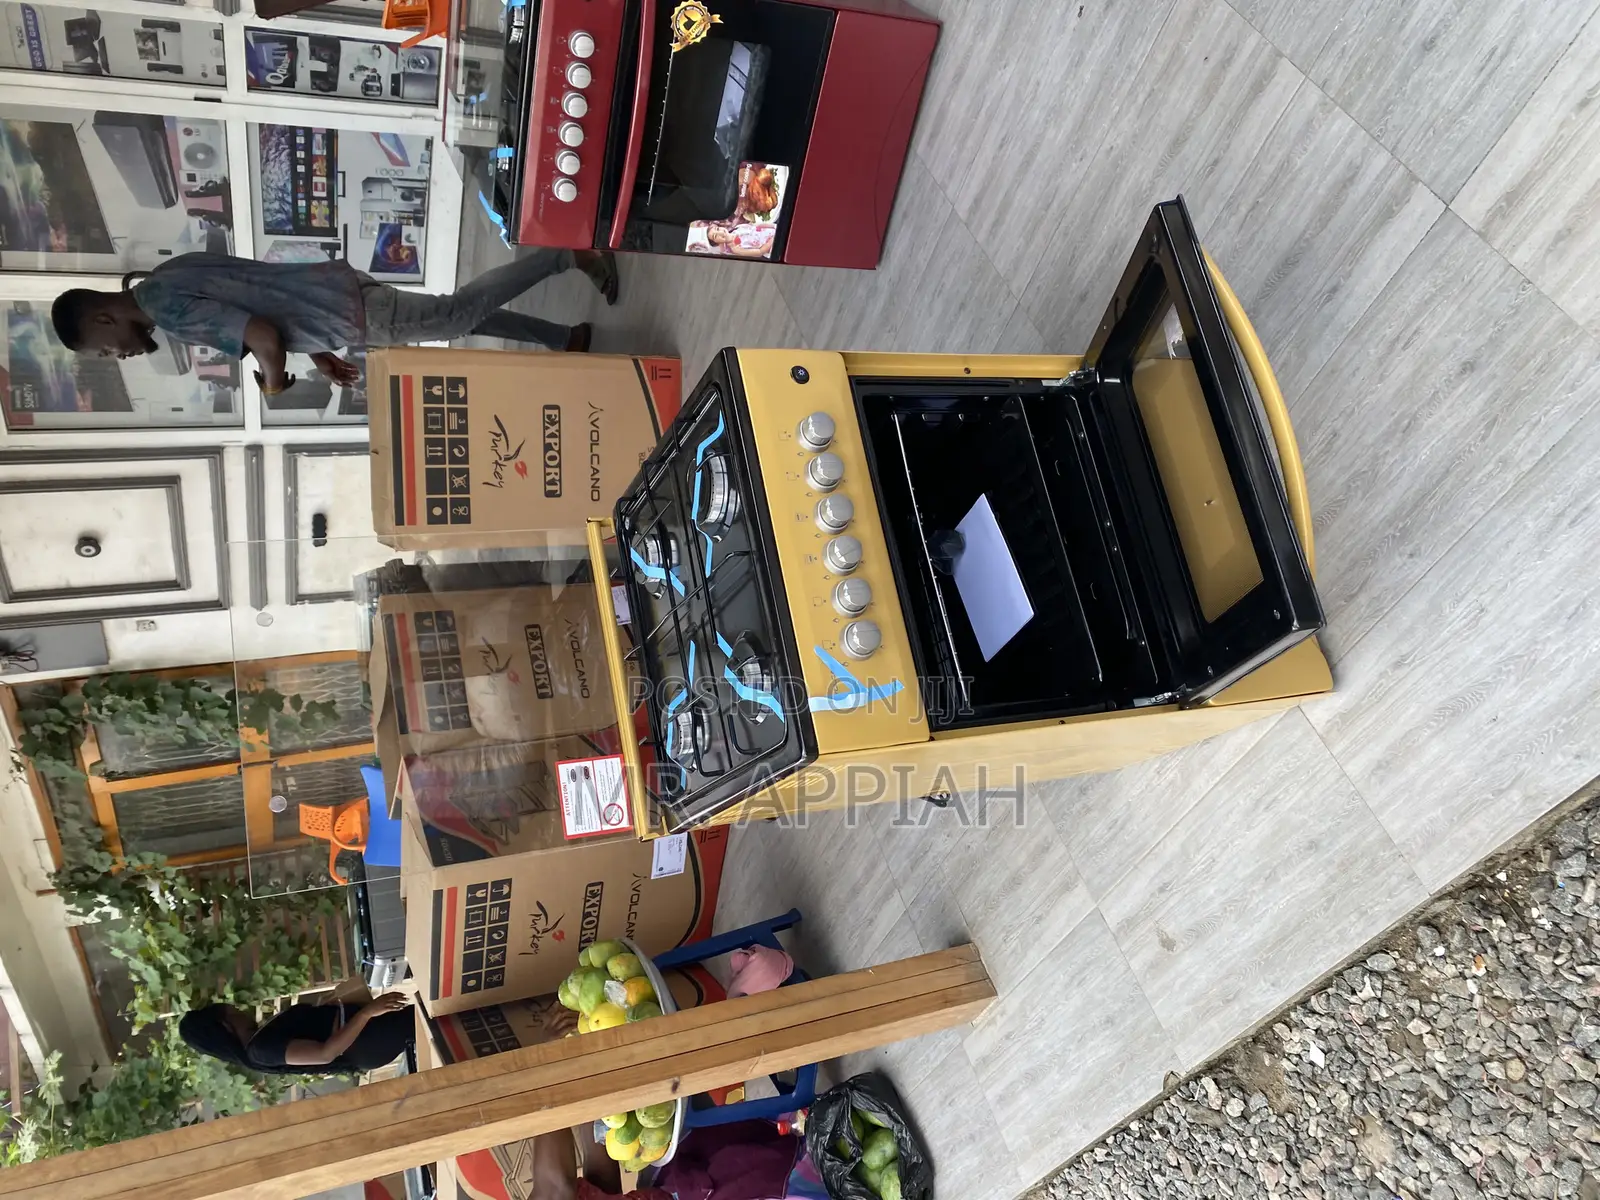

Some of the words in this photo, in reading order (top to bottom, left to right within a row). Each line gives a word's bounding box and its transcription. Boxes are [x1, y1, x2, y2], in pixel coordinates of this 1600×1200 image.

[26, 9, 36, 37] GREAT
[30, 40, 39, 48] IS
[33, 50, 43, 68] GOD
[742, 164, 752, 182] cooking
[482, 415, 510, 489] Turkey
[544, 408, 561, 495] EXPORT
[589, 417, 601, 502] VOLCANO
[526, 626, 552, 697] EXPORT
[569, 630, 590, 699] VOLCANO
[562, 782, 571, 816] ATTENTION!
[518, 901, 552, 956] Turkey
[581, 885, 601, 948] EXPORT
[626, 884, 642, 940] VOLCAN
